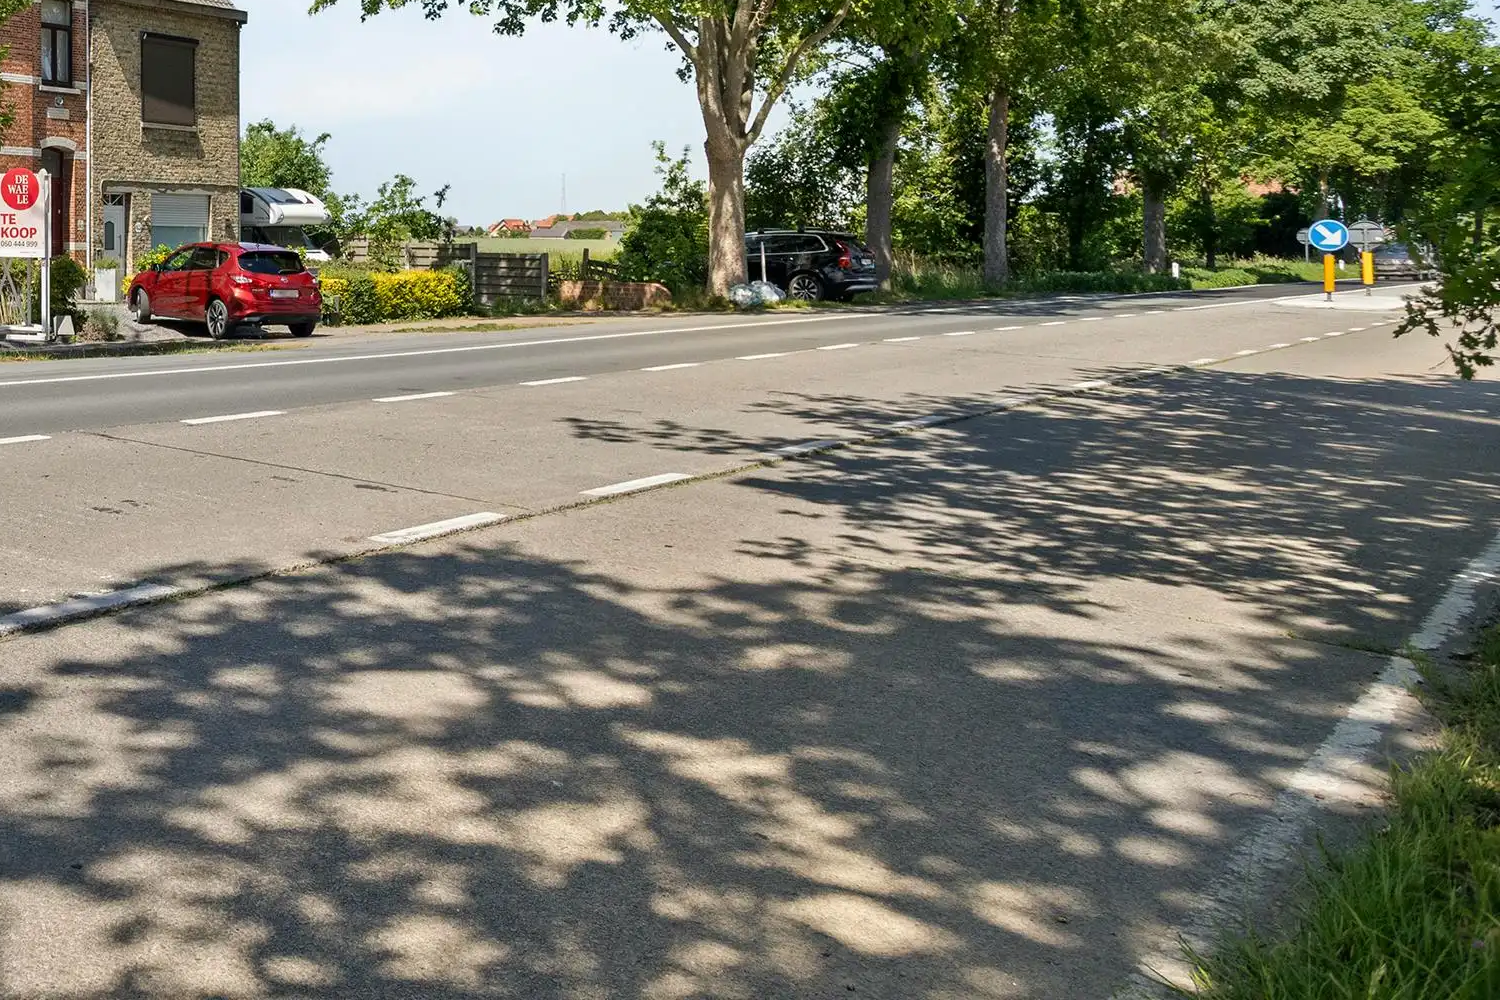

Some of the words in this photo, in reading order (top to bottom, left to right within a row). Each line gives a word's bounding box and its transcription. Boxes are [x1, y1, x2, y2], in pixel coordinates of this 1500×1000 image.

[15, 174, 29, 184] DE
[7, 184, 29, 194] WAE
[16, 194, 29, 204] LE
[0, 213, 16, 224] TE
[1, 227, 37, 238] KOOP
